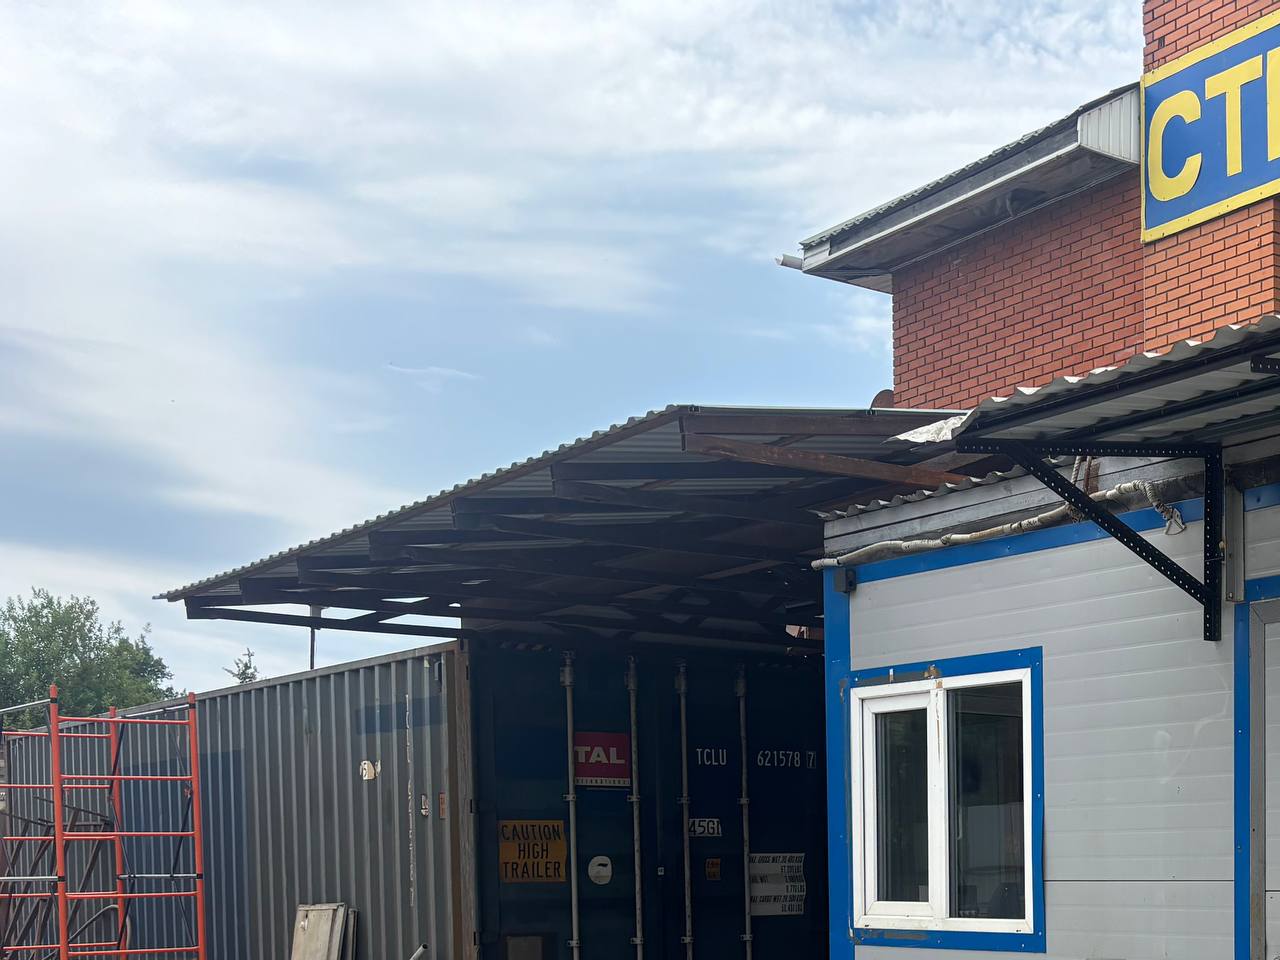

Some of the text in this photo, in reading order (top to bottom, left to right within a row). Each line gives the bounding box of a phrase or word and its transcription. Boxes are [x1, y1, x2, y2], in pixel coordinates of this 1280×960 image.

[574, 746, 625, 764] TAL
[696, 748, 815, 768] TCLU 621578 7
[501, 824, 561, 840] CAUTION
[518, 842, 549, 859] HIGH
[503, 861, 561, 878] TRAILER
